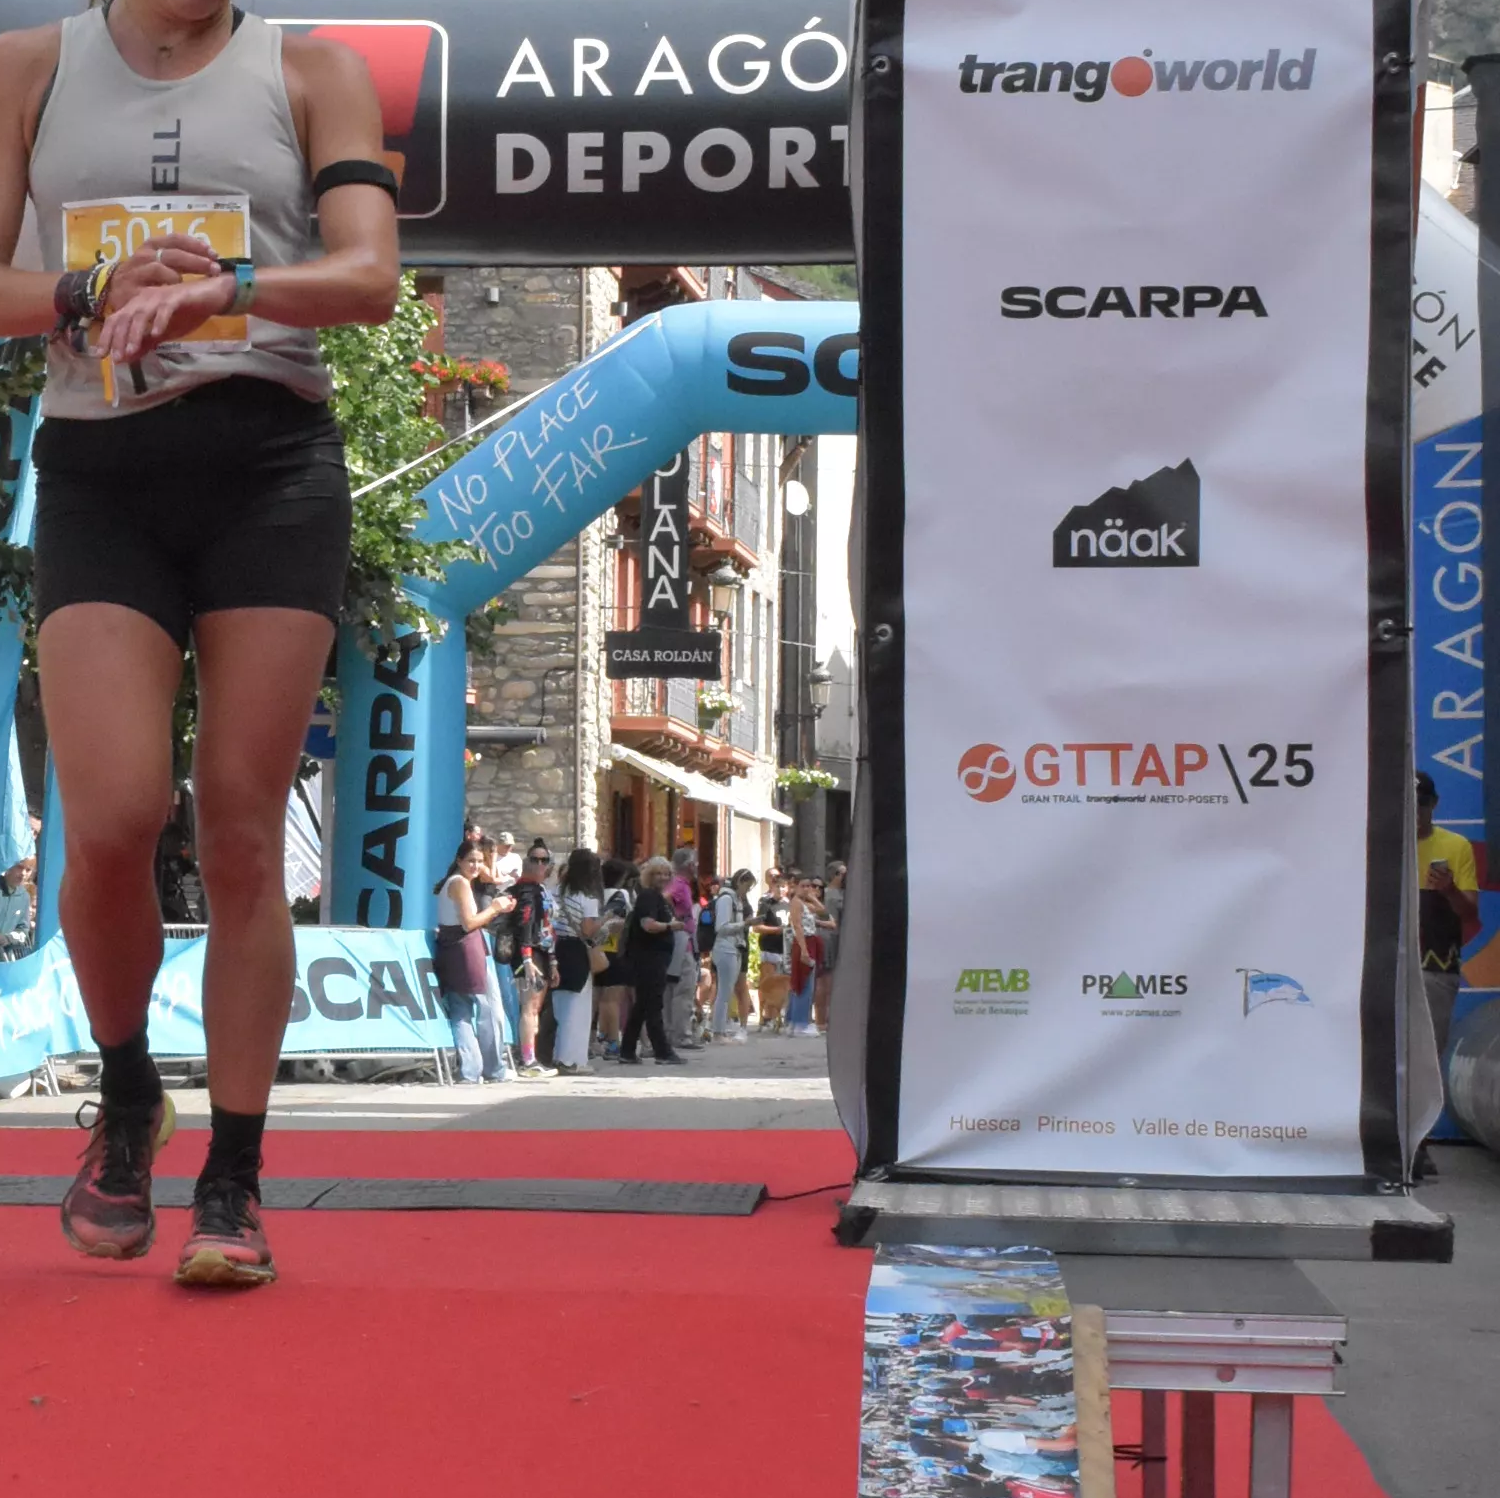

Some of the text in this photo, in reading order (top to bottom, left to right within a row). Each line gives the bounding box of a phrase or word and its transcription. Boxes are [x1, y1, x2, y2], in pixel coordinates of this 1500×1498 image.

[152, 118, 181, 191] ELL
[1000, 286, 1269, 319] SCARPA
[438, 370, 599, 531] NO PLACE
[1070, 518, 1186, 557] näak
[1419, 441, 1484, 780] ARAGÓN
[612, 645, 714, 662] CASA ROLDÁN
[1021, 795, 1051, 804] GRAN
[1053, 795, 1081, 803] TRAIL
[1149, 794, 1229, 804] ANETO-POSETS
[955, 968, 1031, 993] ATEVB
[1082, 970, 1189, 999] PRAMES
[1101, 1008, 1182, 1018] www.prames.com
[949, 1115, 1308, 1142] Huesca Pirineos Valle de Benasque
